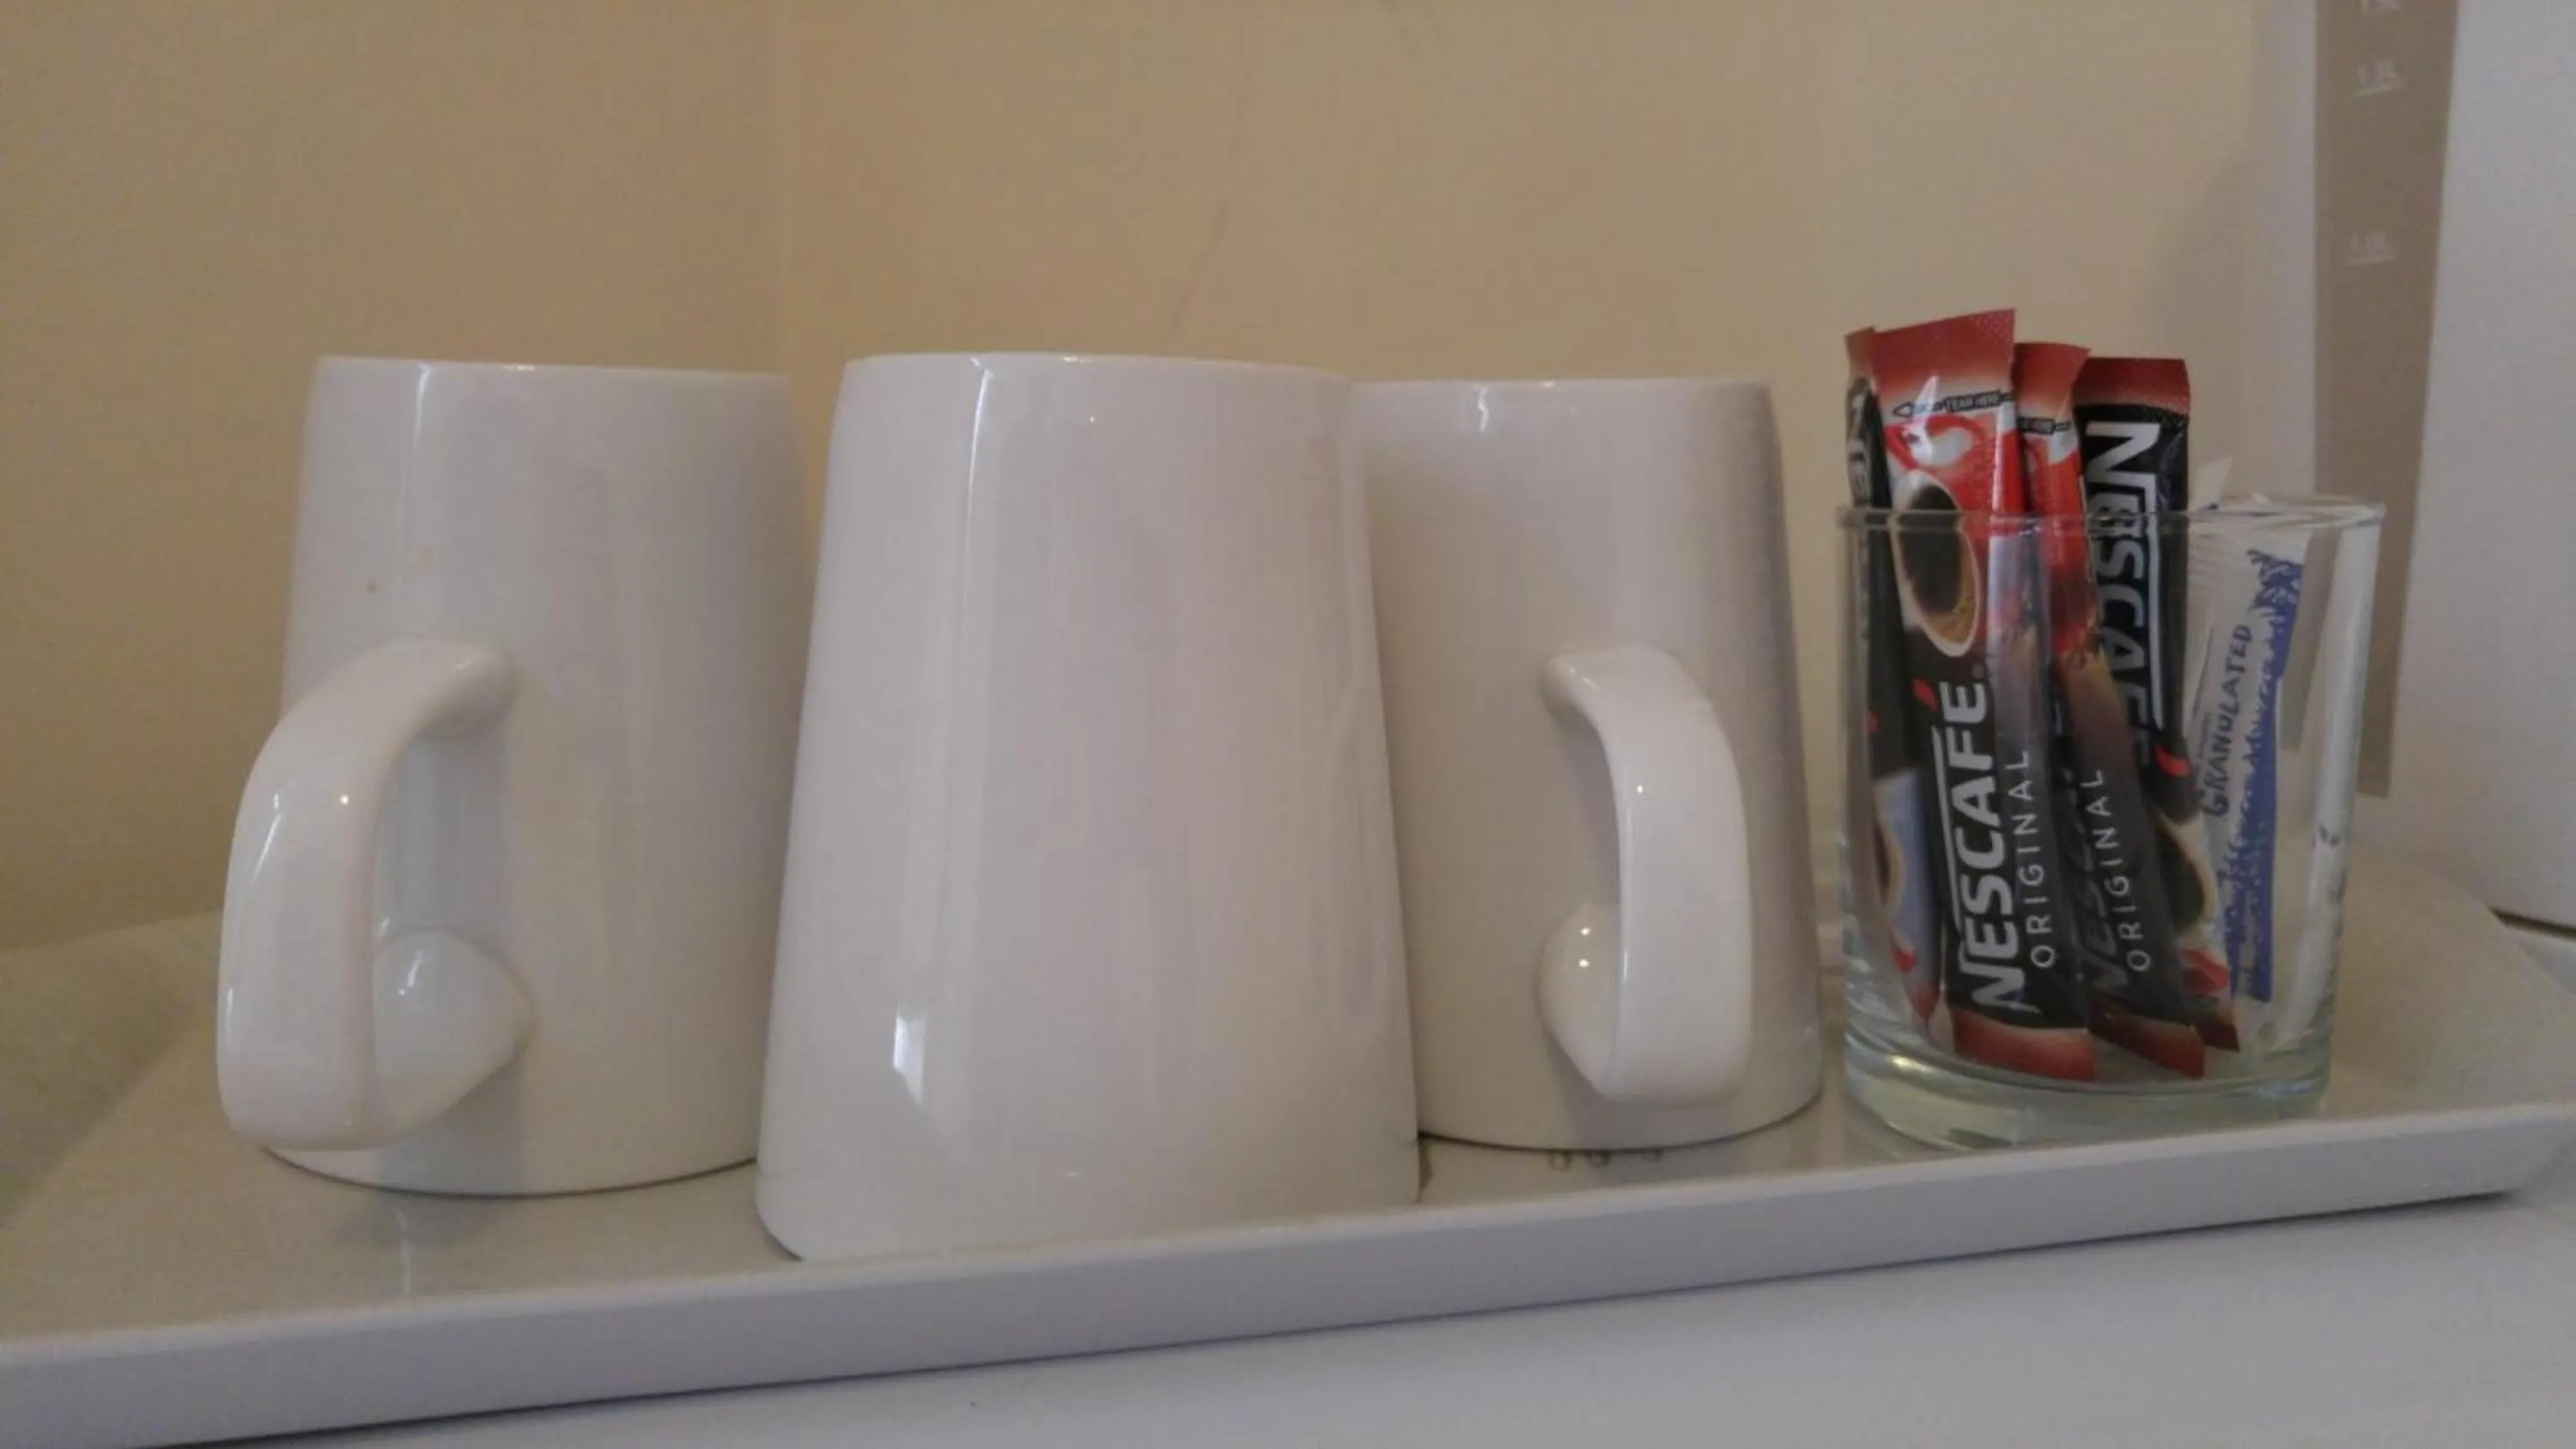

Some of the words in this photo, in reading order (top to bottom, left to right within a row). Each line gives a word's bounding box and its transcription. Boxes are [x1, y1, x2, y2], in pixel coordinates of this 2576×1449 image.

[2201, 624, 2253, 818] GRANULATED
[2004, 750, 2057, 968] ORIGINAL
[2081, 770, 2152, 972] ORIGINAL
